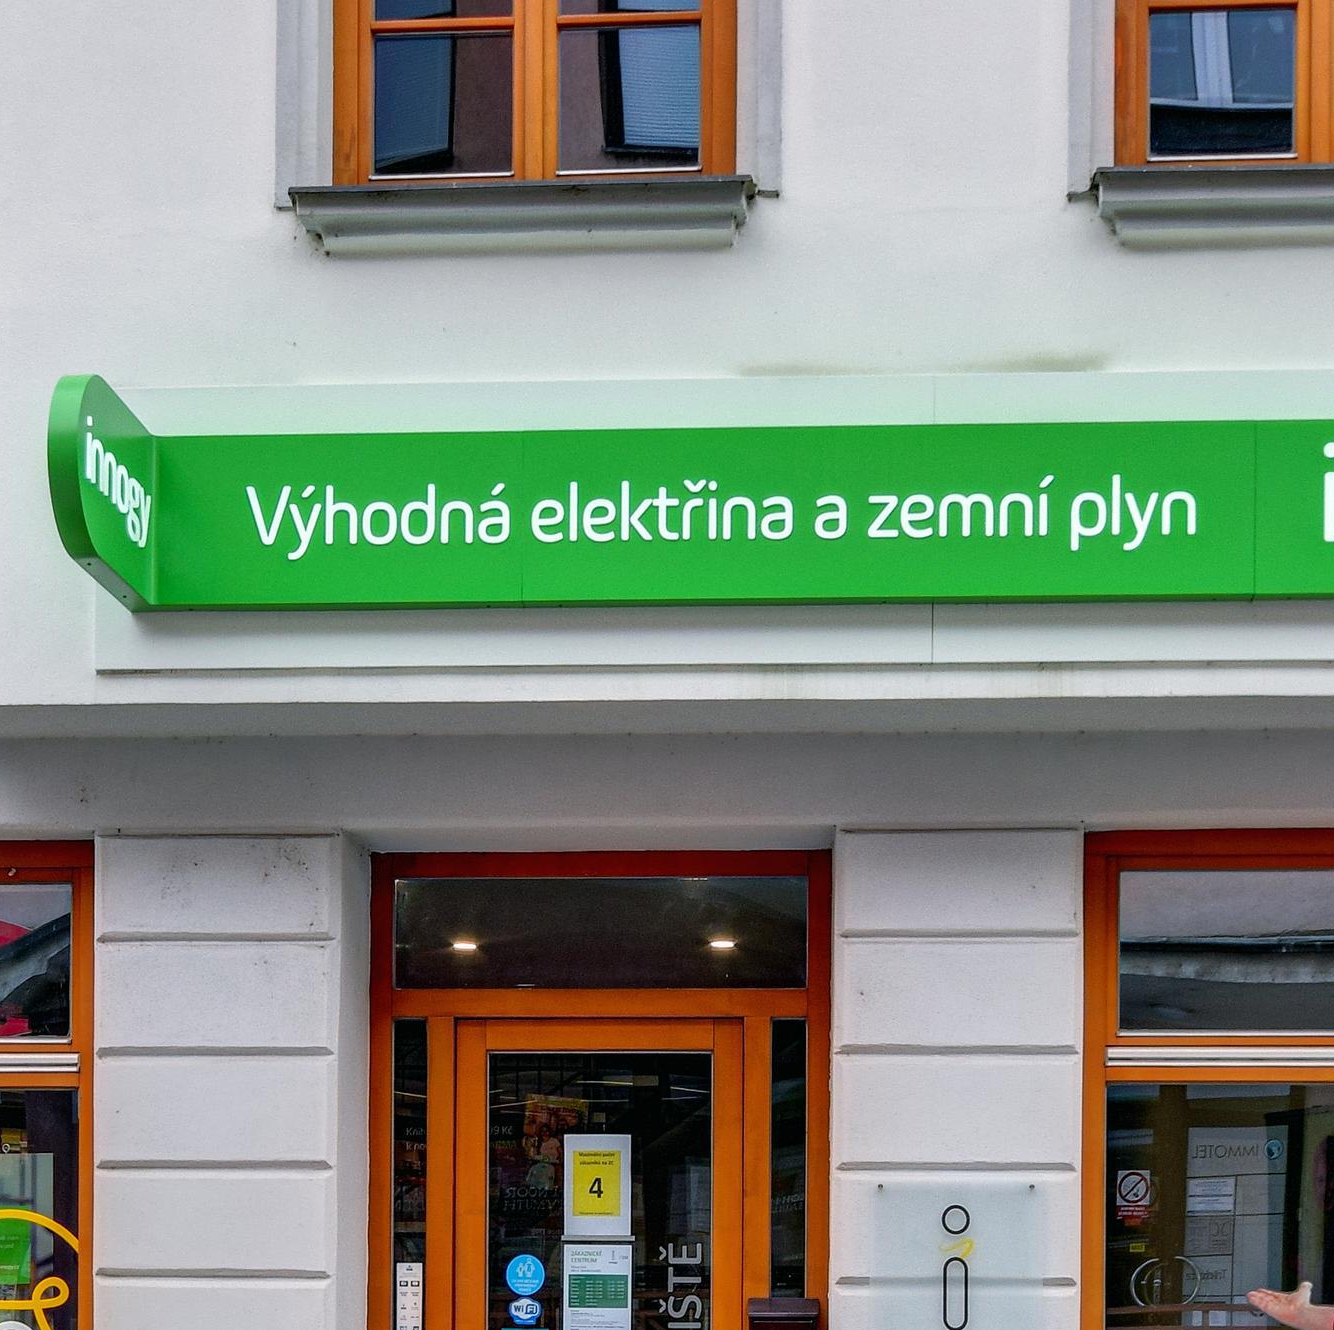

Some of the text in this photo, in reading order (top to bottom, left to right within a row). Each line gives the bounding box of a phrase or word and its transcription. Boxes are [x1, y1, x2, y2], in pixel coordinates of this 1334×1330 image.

[84, 415, 152, 549] innogy
[245, 473, 1197, 560] Výhodná elektřina a zemní plyn
[588, 1177, 604, 1199] 4
